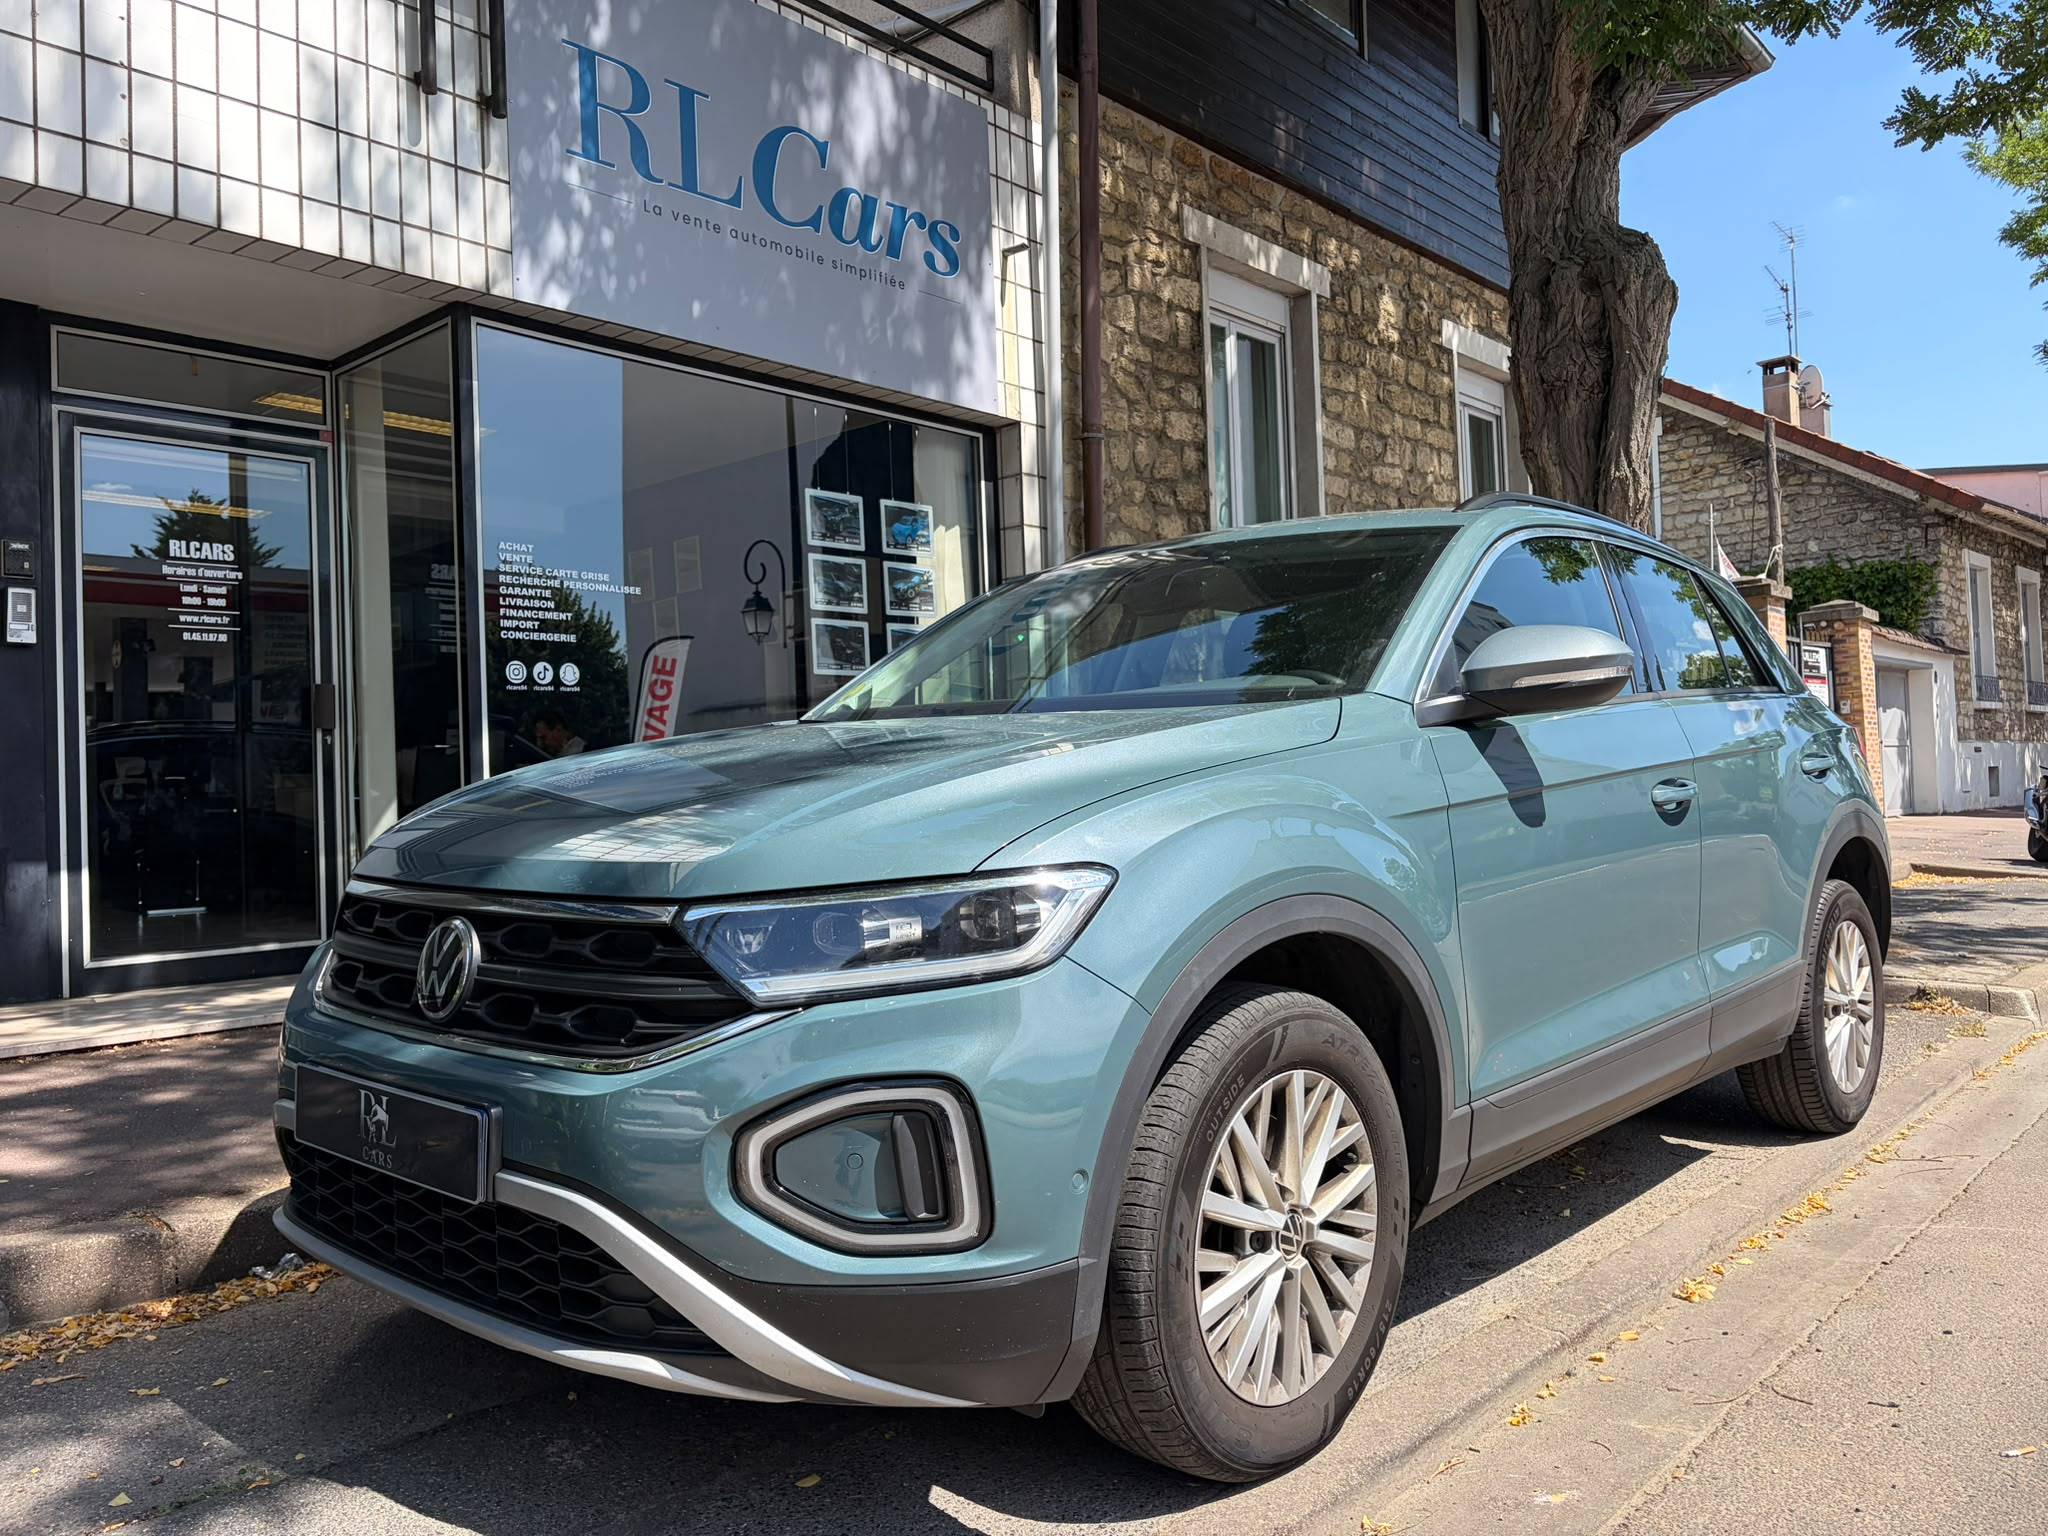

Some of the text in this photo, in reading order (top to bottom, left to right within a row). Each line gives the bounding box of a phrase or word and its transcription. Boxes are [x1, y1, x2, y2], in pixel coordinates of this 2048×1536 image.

[561, 38, 960, 279] RLCars
[643, 199, 906, 291] La vente automobile simplifiée
[169, 539, 235, 561] RLCARS
[499, 541, 534, 553] ACHAT
[499, 552, 533, 563] VENTE
[162, 564, 243, 579] Horaires d'ouverture
[499, 563, 610, 582] SERVICE CARTE GRISE
[499, 575, 641, 595] RECHERCHE PERSONNALISEE
[499, 586, 552, 598] GARANTIE
[499, 597, 555, 609] LIVRAISON
[179, 615, 230, 624] www.rlcars.fr
[499, 608, 573, 621] FINANCEMENT
[500, 619, 540, 630] IMPORT
[500, 630, 577, 643] CONCIERGERIE
[1206, 1073, 1246, 1143] OUTSIDE
[361, 1145, 394, 1170] CARS
